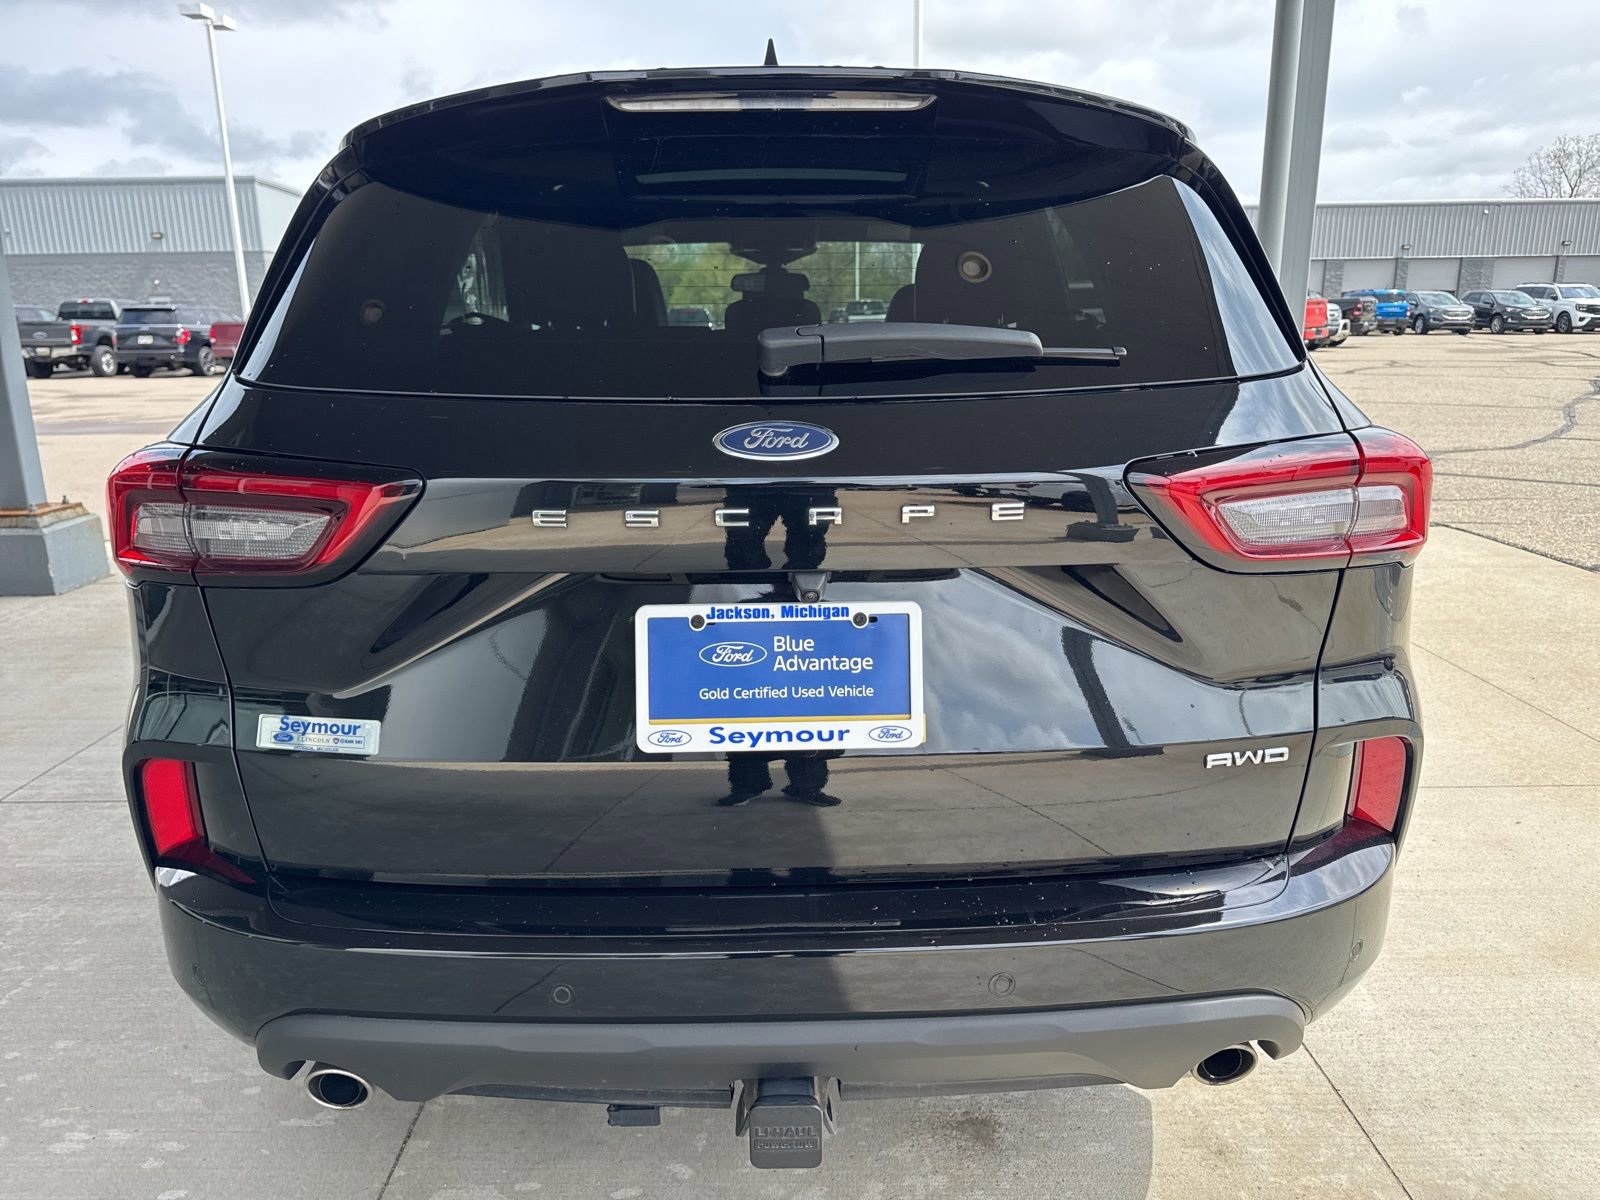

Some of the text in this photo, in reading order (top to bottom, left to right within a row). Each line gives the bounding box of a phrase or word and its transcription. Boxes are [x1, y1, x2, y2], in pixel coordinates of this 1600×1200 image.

[743, 427, 810, 449] Ford
[532, 502, 1025, 528] ESCAPE
[706, 605, 849, 620] Jackson, Michigan
[773, 636, 814, 652] Blue
[712, 645, 754, 663] Ford
[773, 654, 873, 673] Advantage
[699, 684, 874, 700] Gold Certified Used Vehicle
[279, 715, 362, 736] Seymour
[877, 729, 904, 740] Ford
[301, 736, 330, 744] LINCOLN
[657, 733, 683, 744] Ford
[709, 727, 850, 748] Seymour
[1205, 747, 1289, 769] AWD
